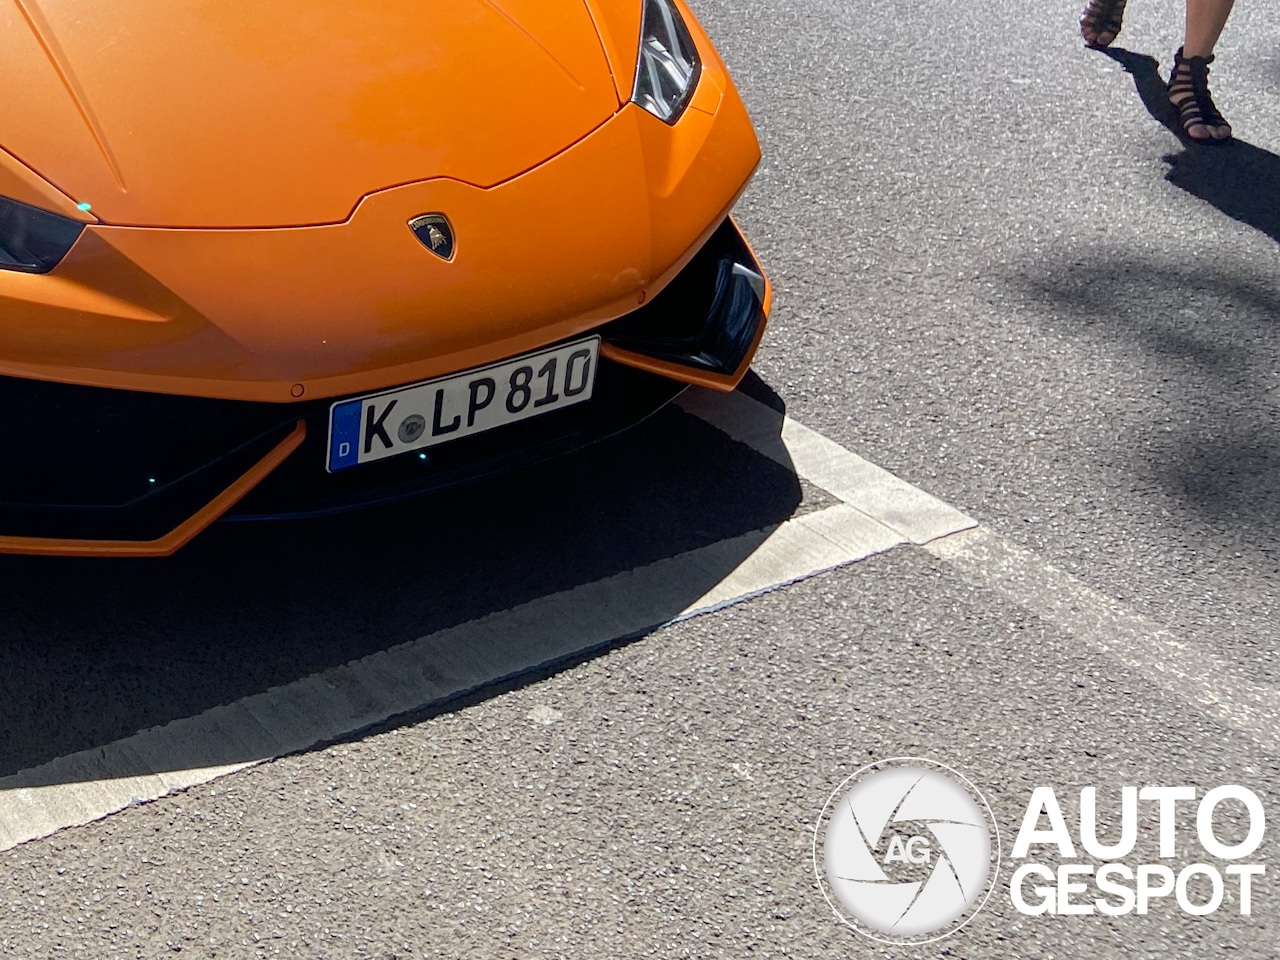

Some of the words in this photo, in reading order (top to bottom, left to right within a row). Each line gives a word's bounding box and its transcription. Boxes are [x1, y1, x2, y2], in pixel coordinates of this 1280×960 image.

[364, 399, 398, 454] K
[432, 377, 496, 437] LP
[505, 349, 592, 414] 810
[339, 442, 350, 457] D
